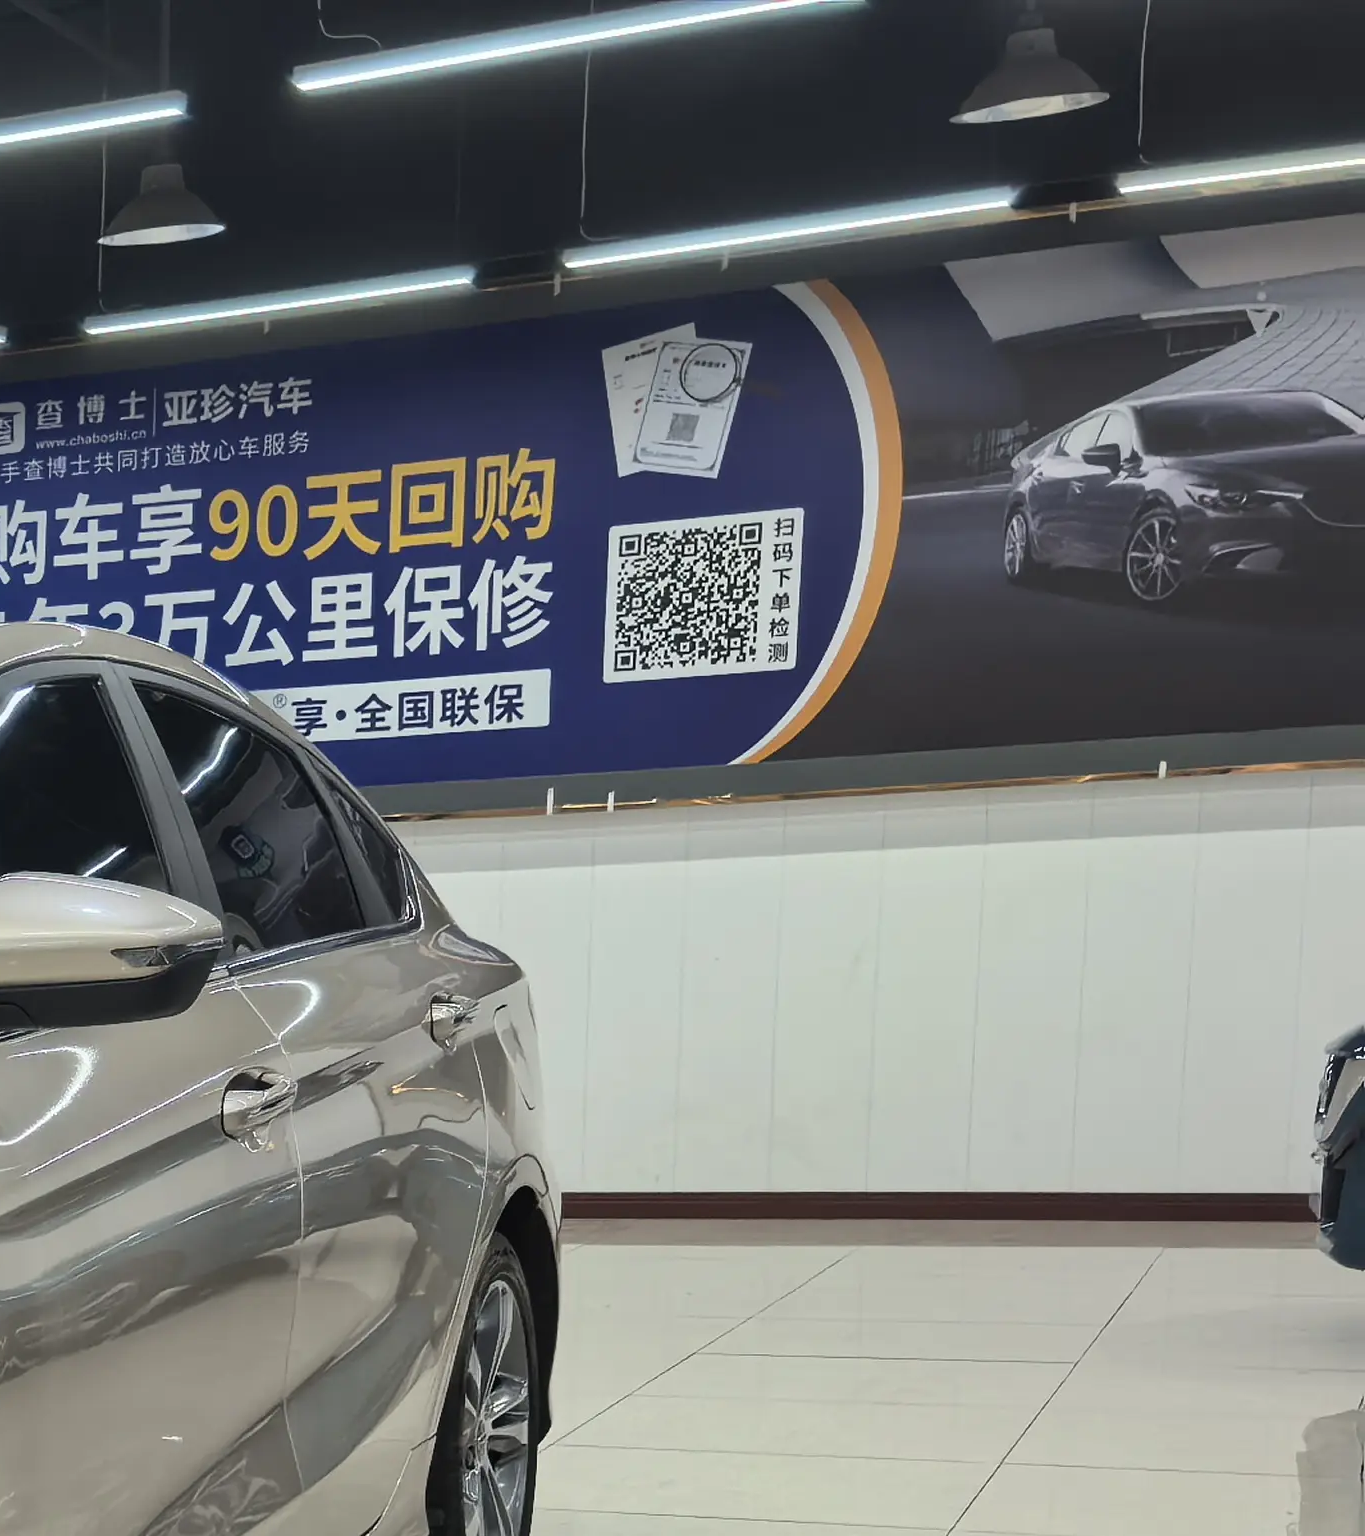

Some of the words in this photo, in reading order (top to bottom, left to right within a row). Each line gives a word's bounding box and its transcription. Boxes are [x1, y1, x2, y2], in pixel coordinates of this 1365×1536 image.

[163, 376, 312, 426] 亚珍汽车
[767, 517, 795, 663] 扫码下单检测
